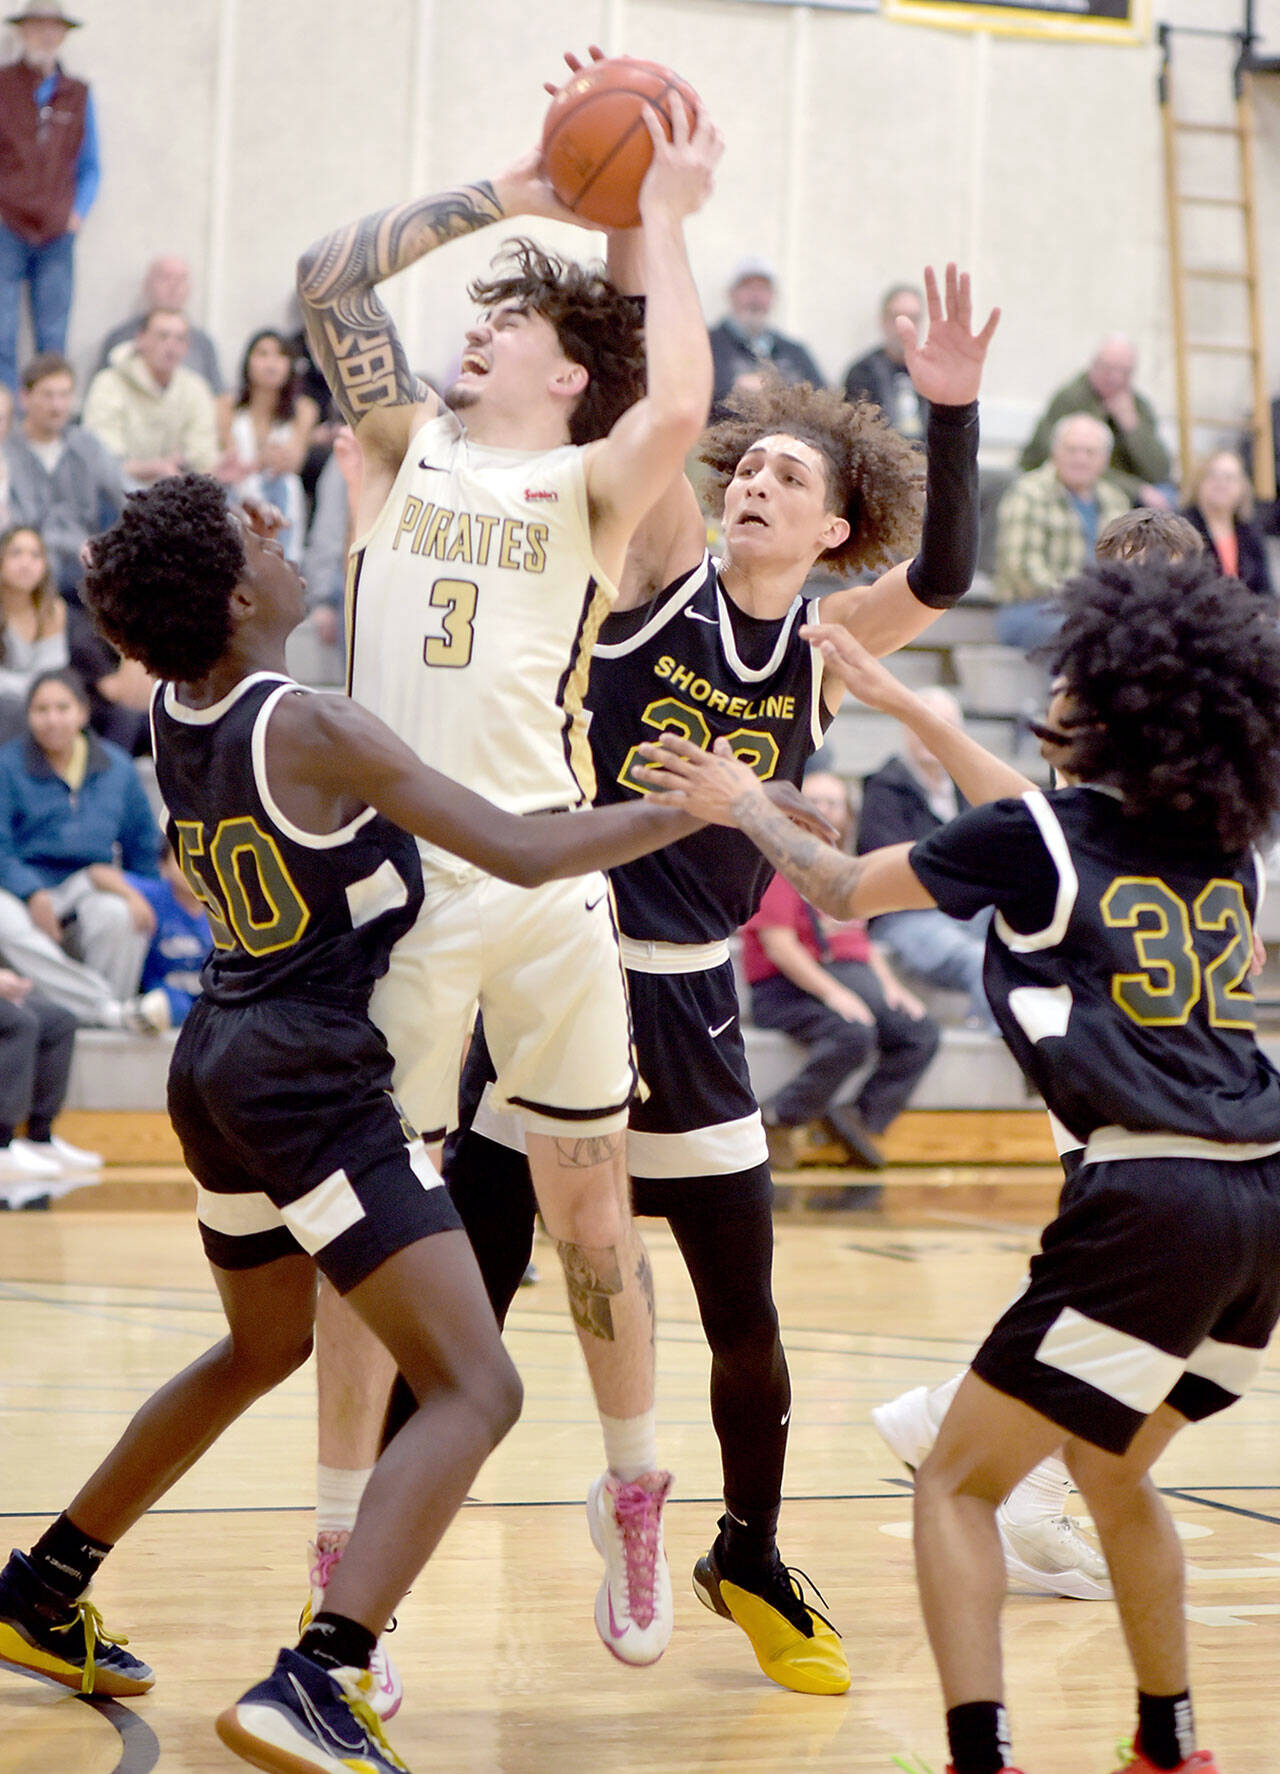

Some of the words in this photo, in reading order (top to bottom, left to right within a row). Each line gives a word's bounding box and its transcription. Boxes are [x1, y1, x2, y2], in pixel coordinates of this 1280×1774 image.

[392, 494, 549, 574] PIRATES
[423, 578, 479, 669] 3
[653, 655, 796, 720] SHORELINE
[174, 815, 311, 958] 50
[1099, 875, 1258, 1030] 32
